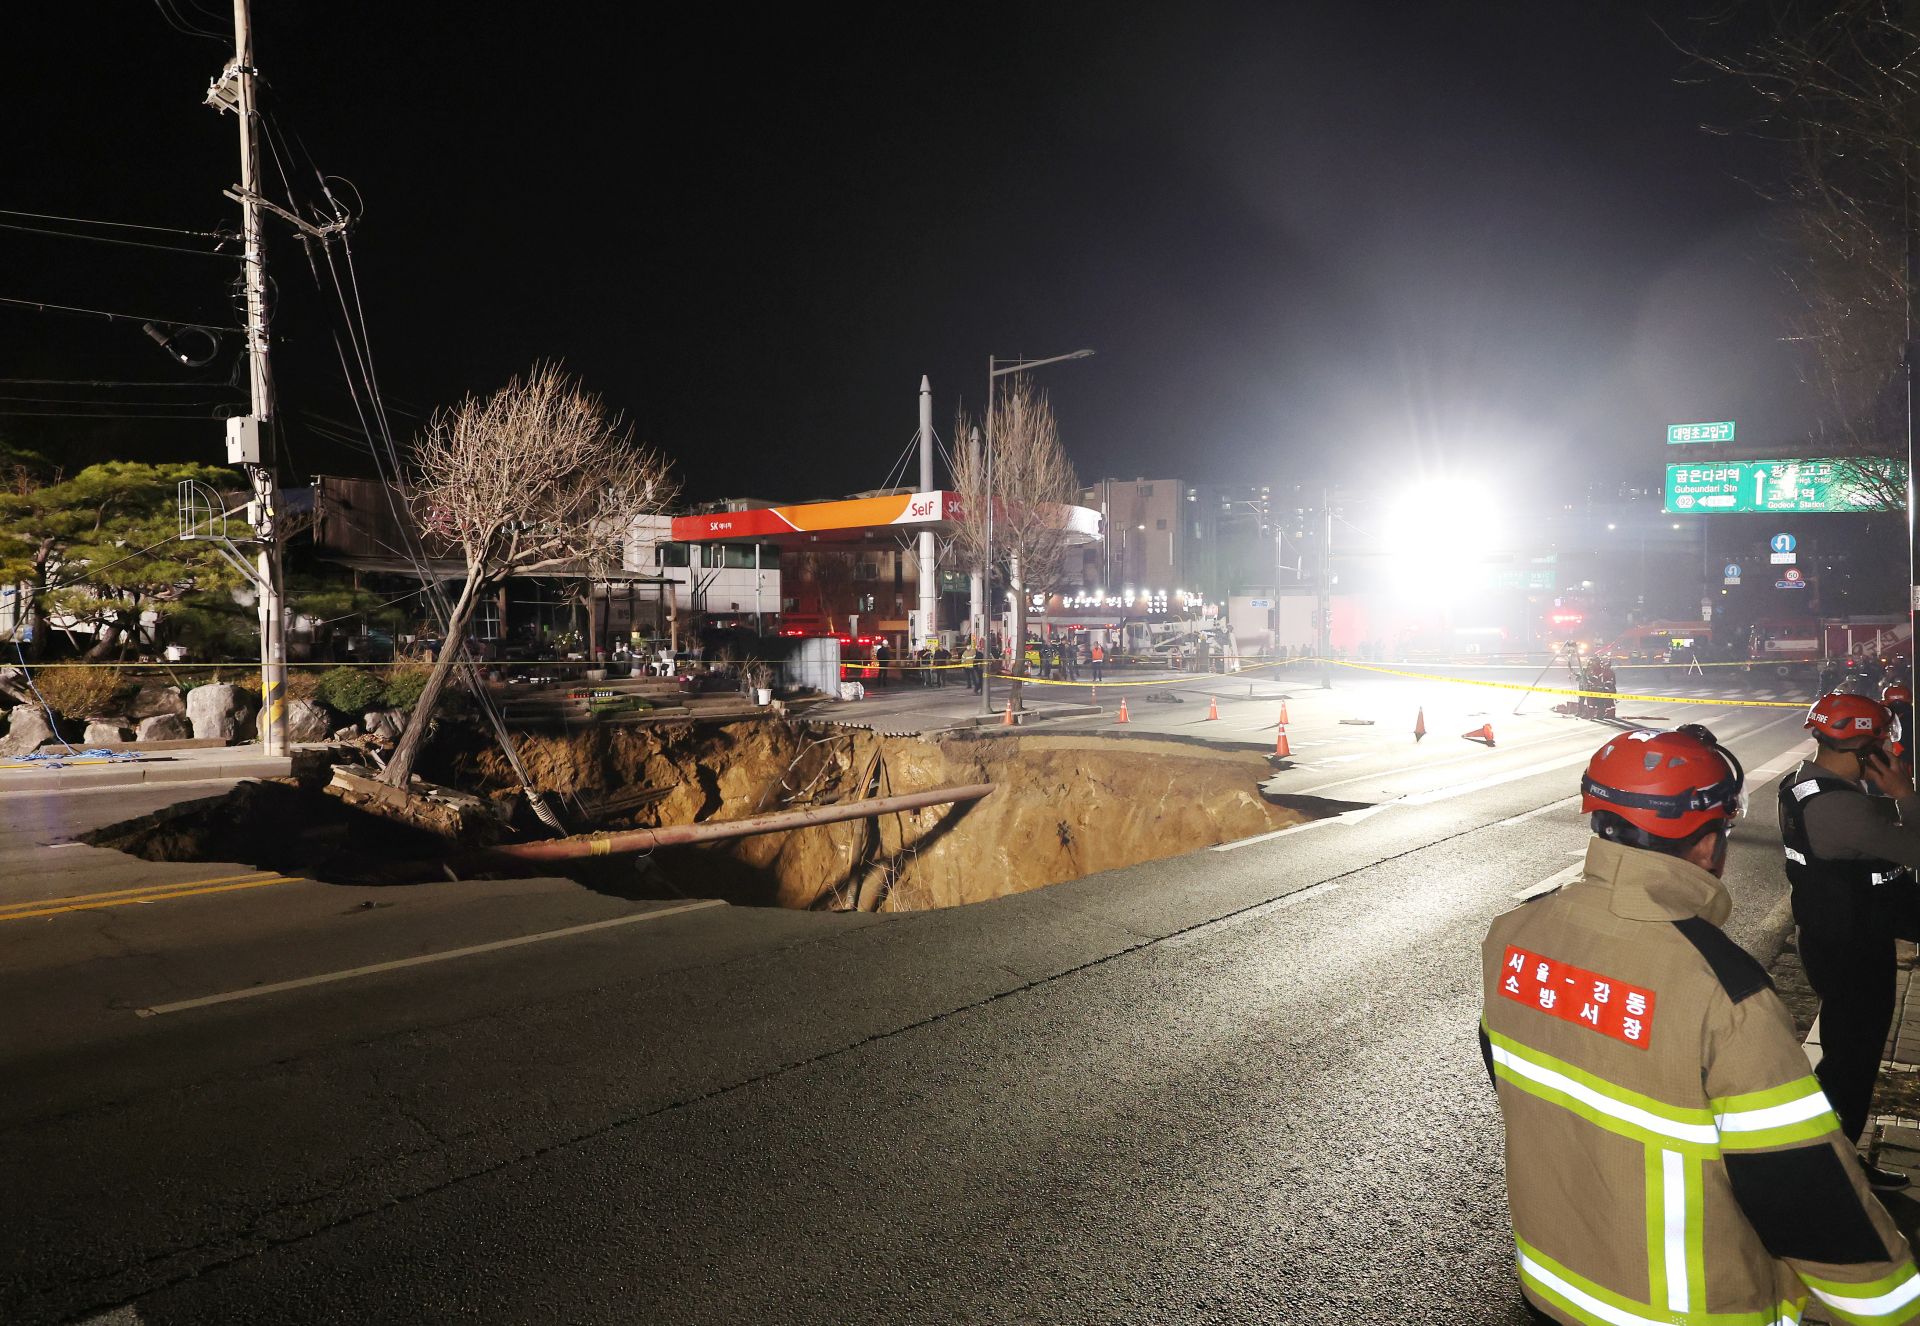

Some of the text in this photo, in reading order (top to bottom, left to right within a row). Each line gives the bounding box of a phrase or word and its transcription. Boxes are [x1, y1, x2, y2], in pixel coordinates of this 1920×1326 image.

[1673, 425, 1728, 440] 대명초교입구
[1675, 468, 1740, 483] 굽은다리역
[1674, 484, 1738, 494] Gubeundari Stn
[948, 501, 961, 513] SK
[1680, 497, 1692, 506] 92
[1800, 501, 1826, 509] Station
[911, 501, 935, 517] Self
[710, 522, 719, 531] SK
[1816, 713, 1829, 724] FIRE
